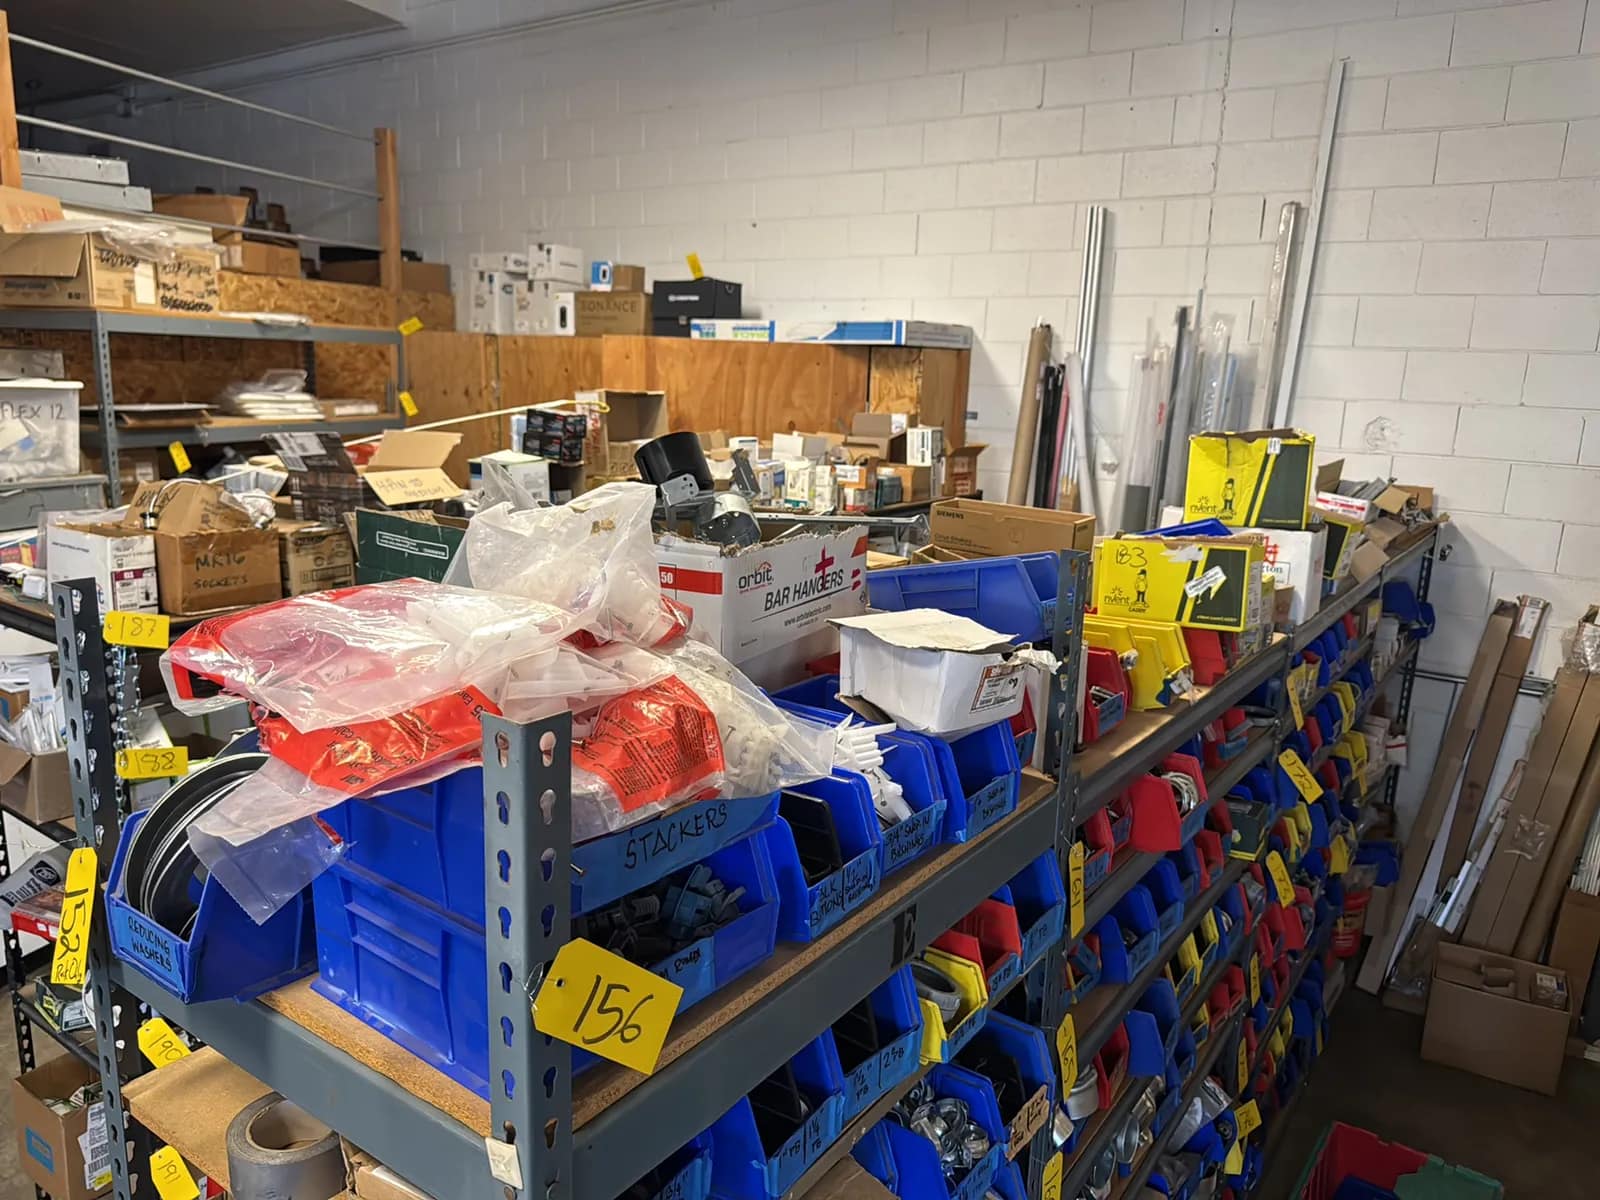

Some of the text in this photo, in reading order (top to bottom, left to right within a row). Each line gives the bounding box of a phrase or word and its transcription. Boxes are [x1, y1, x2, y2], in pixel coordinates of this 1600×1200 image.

[50, 402, 65, 420] 12
[936, 509, 964, 519] SIEMENS
[193, 576, 249, 590] SOCKETS
[661, 570, 673, 584] 50
[738, 564, 774, 590] orbit
[764, 590, 790, 612] BAR
[792, 569, 844, 602] HANGERS
[120, 615, 157, 641] 187
[624, 802, 728, 869] STACKERS
[57, 887, 89, 961] 152
[127, 915, 171, 956] REDUCING
[131, 936, 172, 973] WASHERS
[572, 974, 654, 1045] 156
[147, 1033, 182, 1061] 190
[158, 1160, 181, 1185] 191
